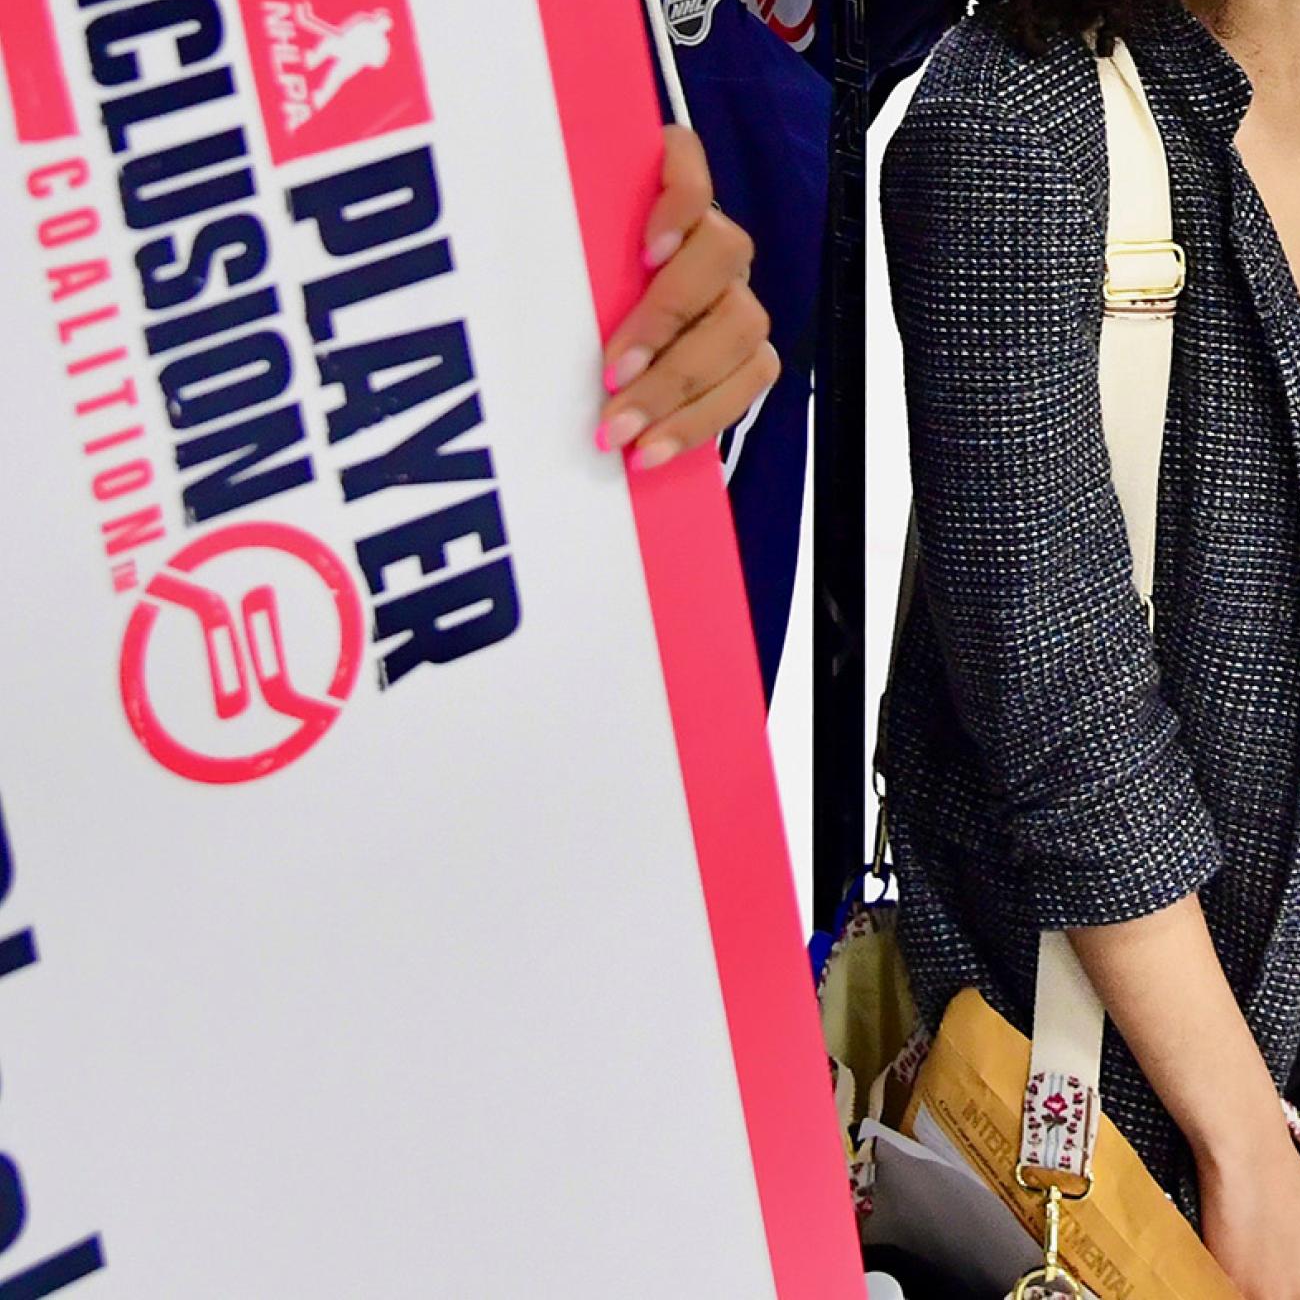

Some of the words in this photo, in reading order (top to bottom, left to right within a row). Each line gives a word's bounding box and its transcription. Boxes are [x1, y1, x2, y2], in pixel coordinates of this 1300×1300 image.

[262, 0, 313, 135] NHLPA
[27, 156, 166, 558] COALITION
[285, 143, 522, 693] PLAYER
